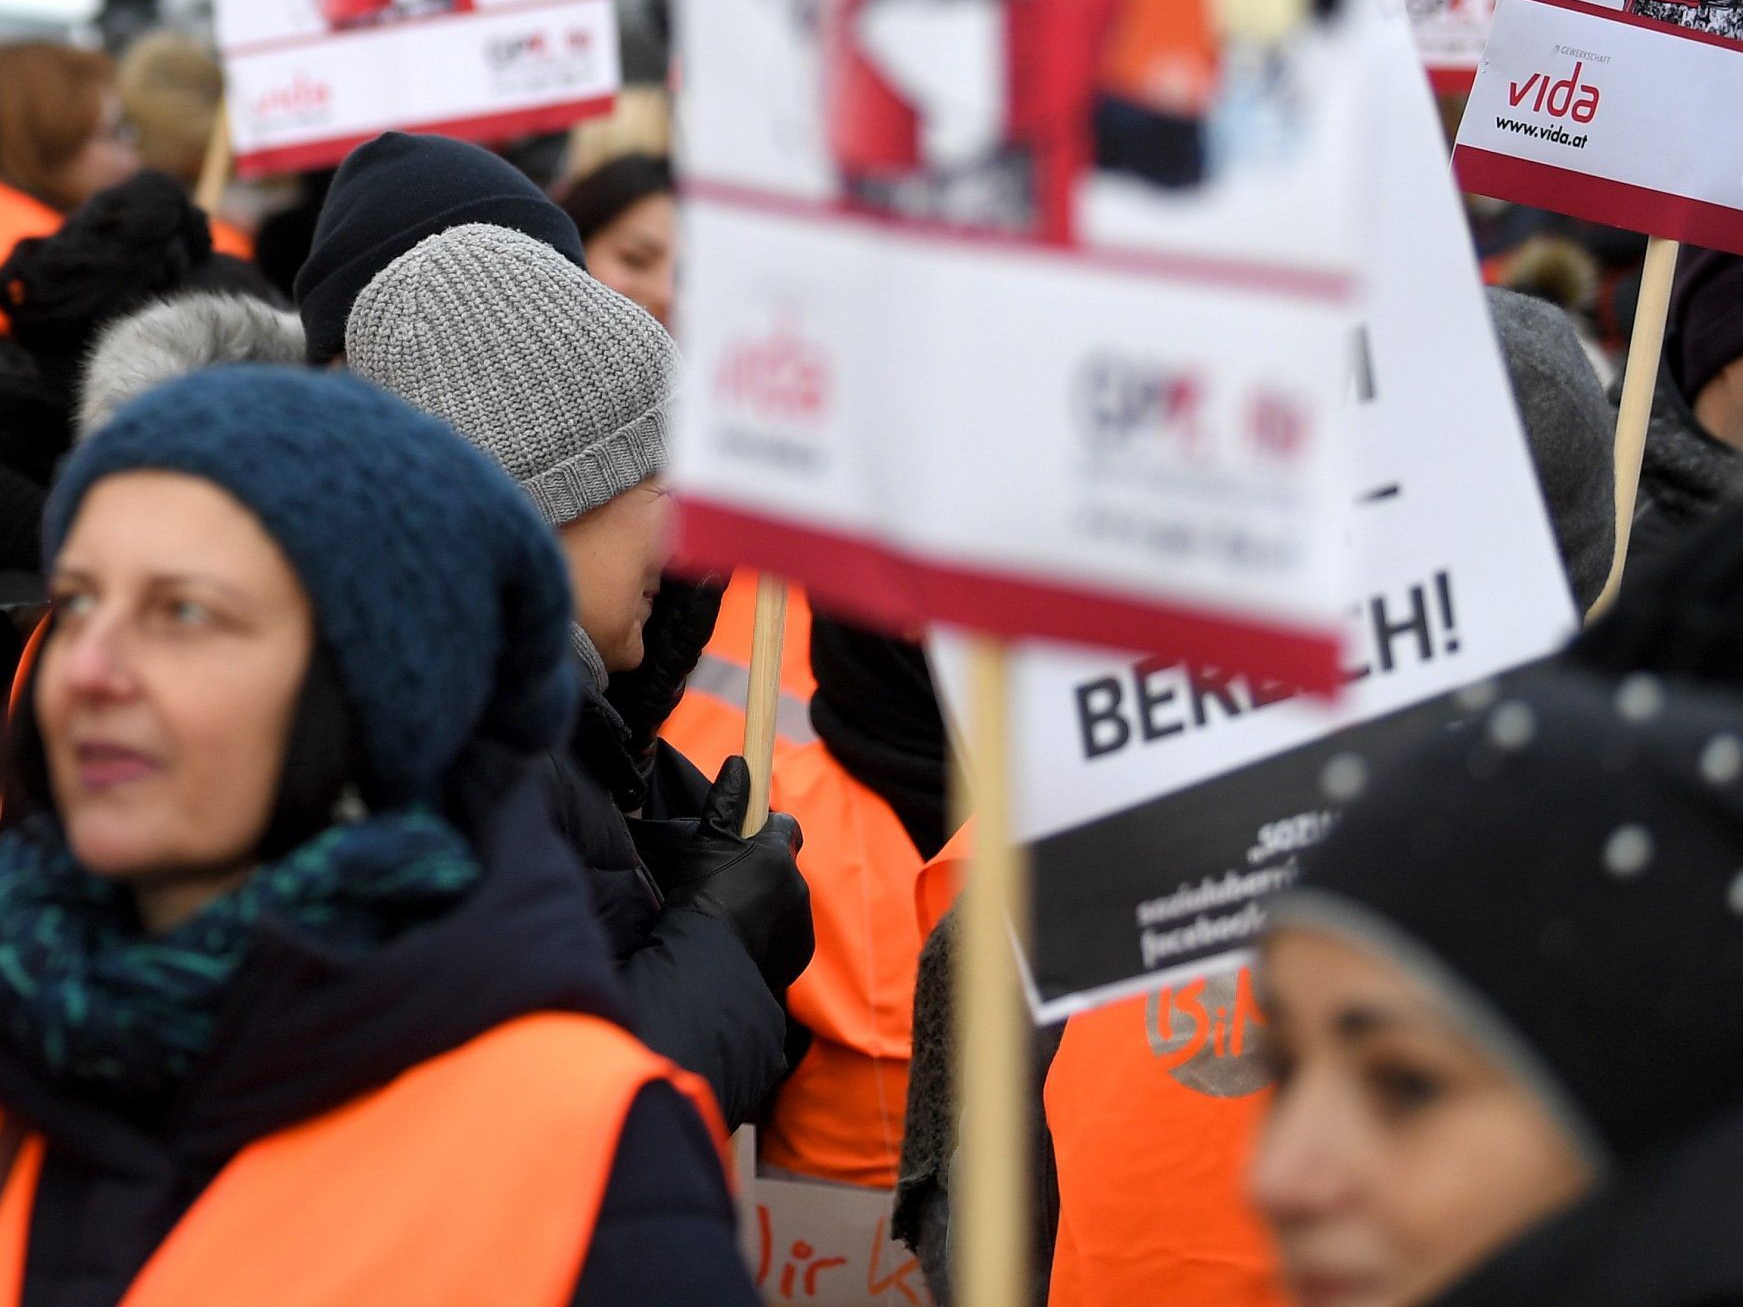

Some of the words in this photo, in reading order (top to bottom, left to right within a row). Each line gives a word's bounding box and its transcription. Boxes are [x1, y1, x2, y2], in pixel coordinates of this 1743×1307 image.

[1560, 45, 1611, 65] GEWERKSCHAFT
[1509, 61, 1600, 124] vida
[1496, 116, 1588, 149] www.vida.at
